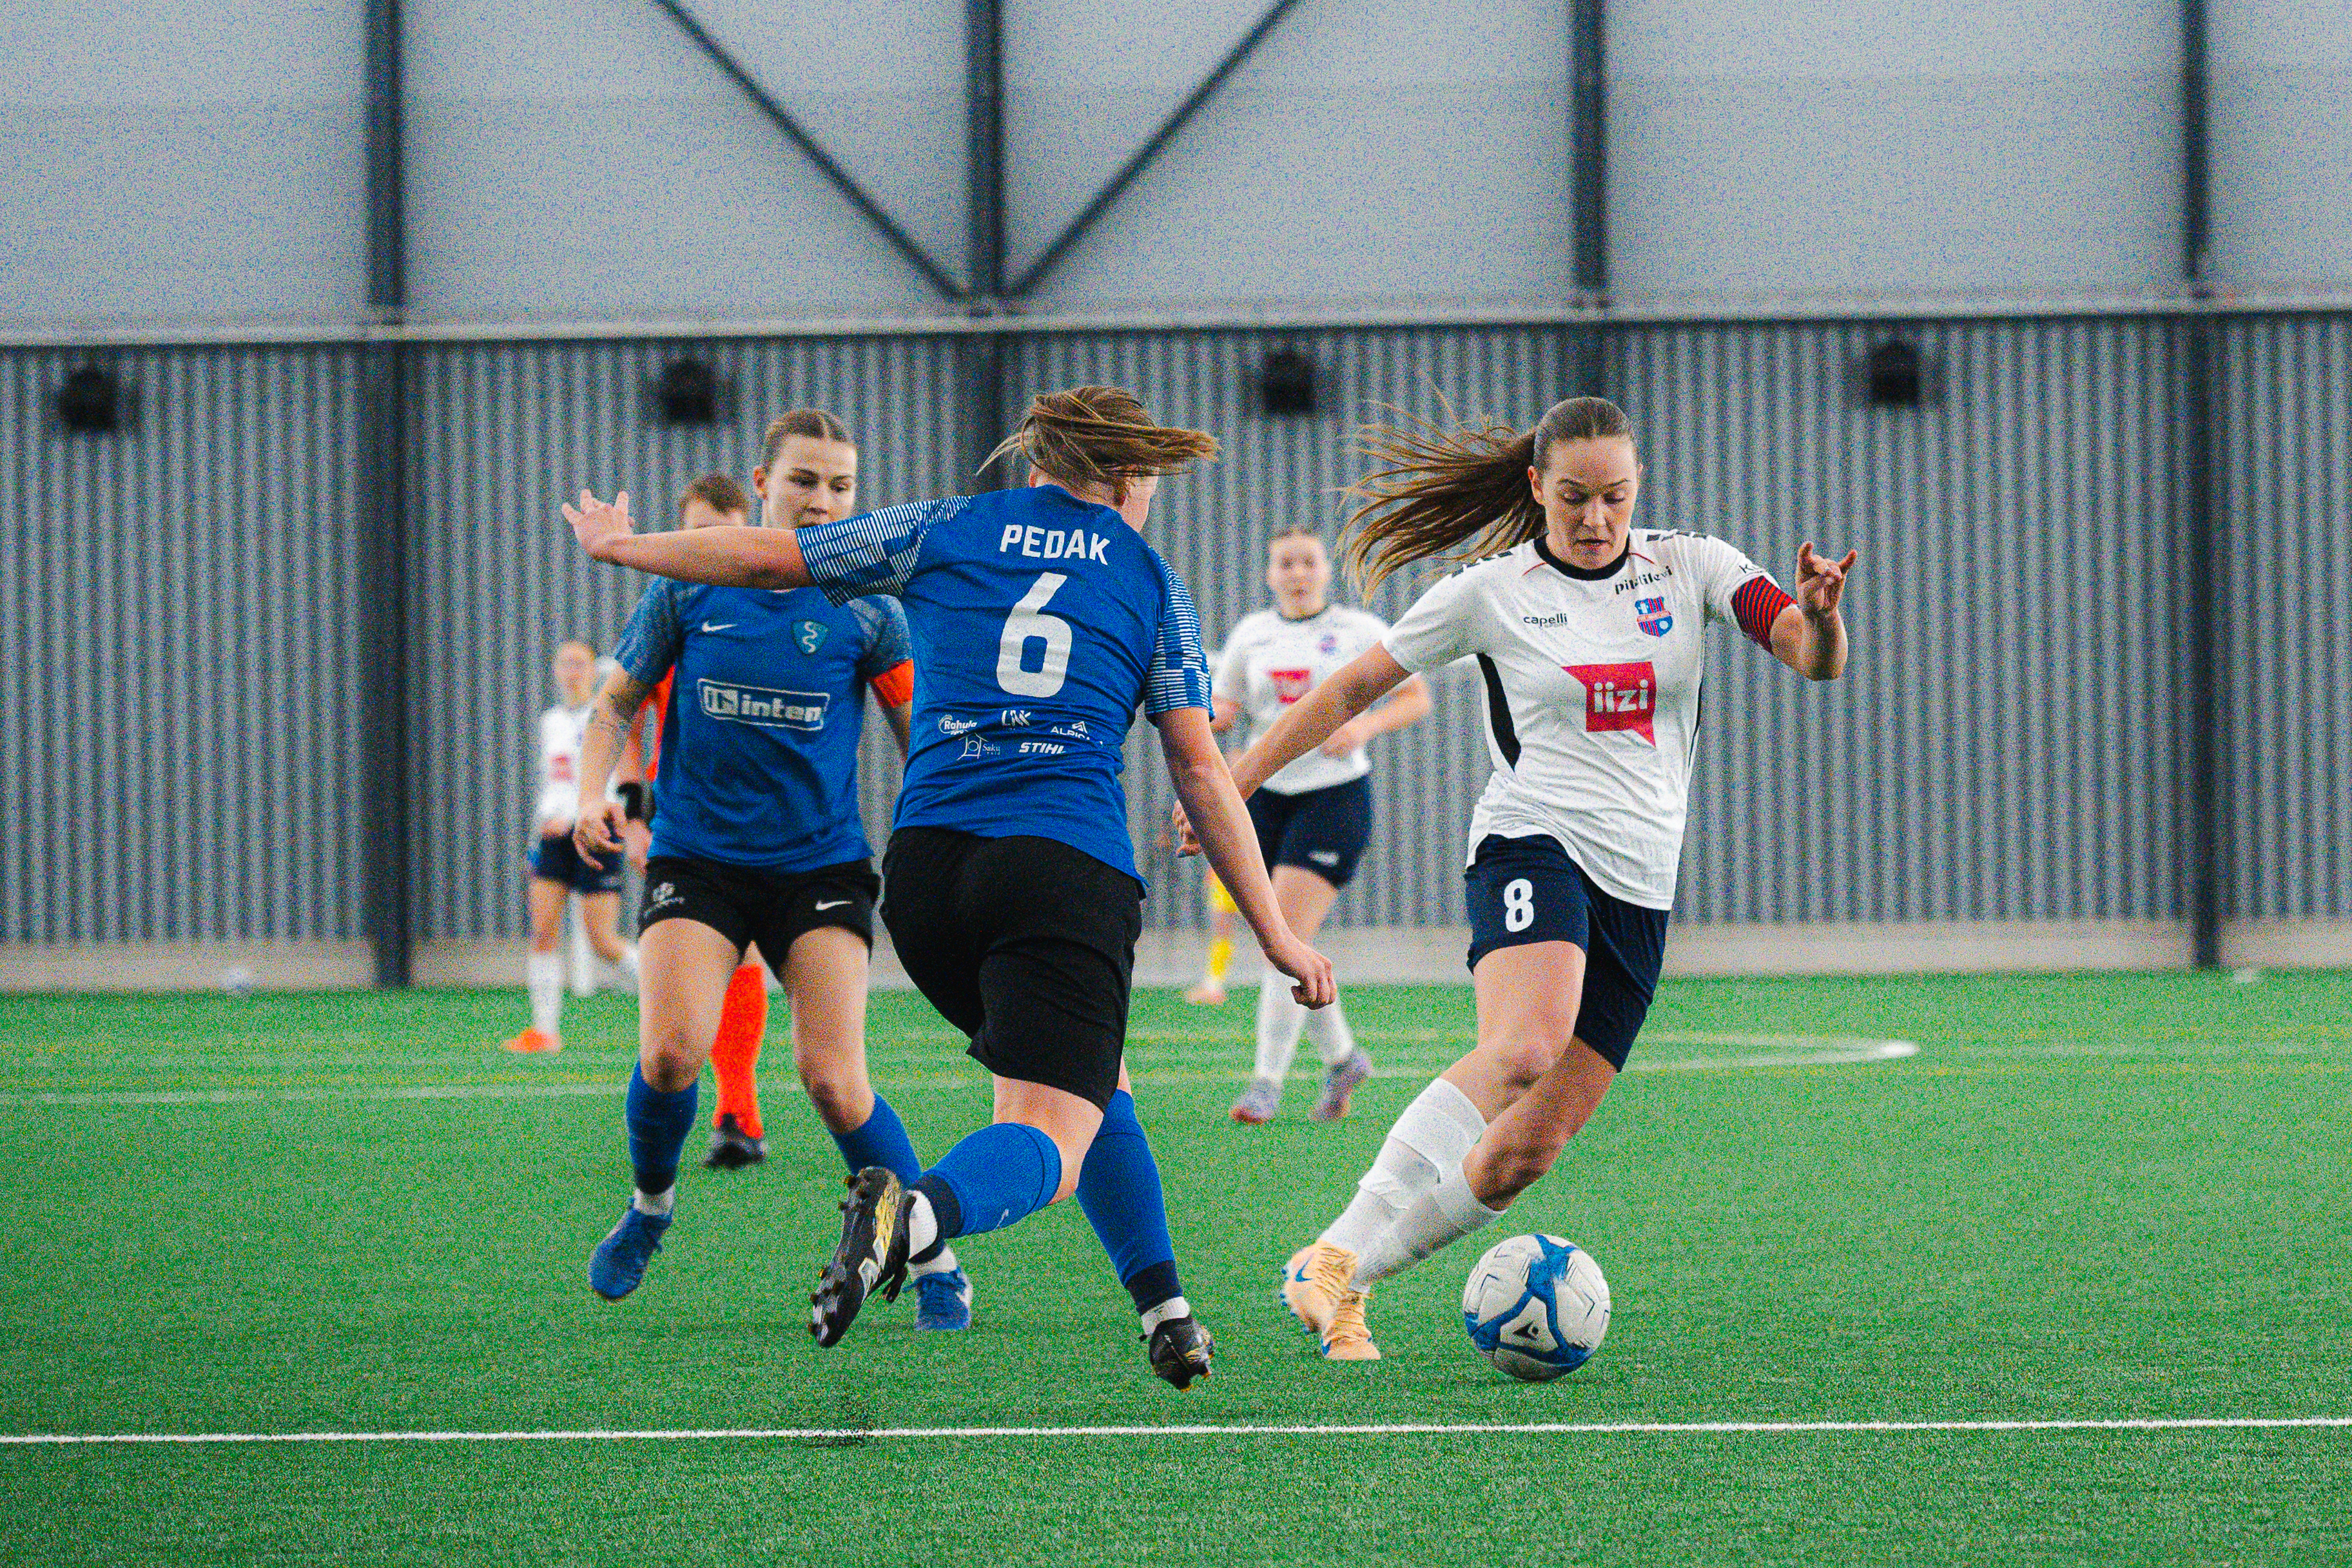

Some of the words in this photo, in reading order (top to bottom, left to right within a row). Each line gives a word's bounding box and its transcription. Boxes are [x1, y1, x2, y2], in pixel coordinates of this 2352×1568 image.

[1000, 524, 1111, 565] PEDAK
[996, 572, 1073, 698] 6
[1523, 613, 1568, 627] capelli
[1593, 679, 1649, 713] iizi
[944, 720, 978, 730] Rahula
[1018, 742, 1067, 755] STIHL
[1504, 878, 1534, 933] 8
